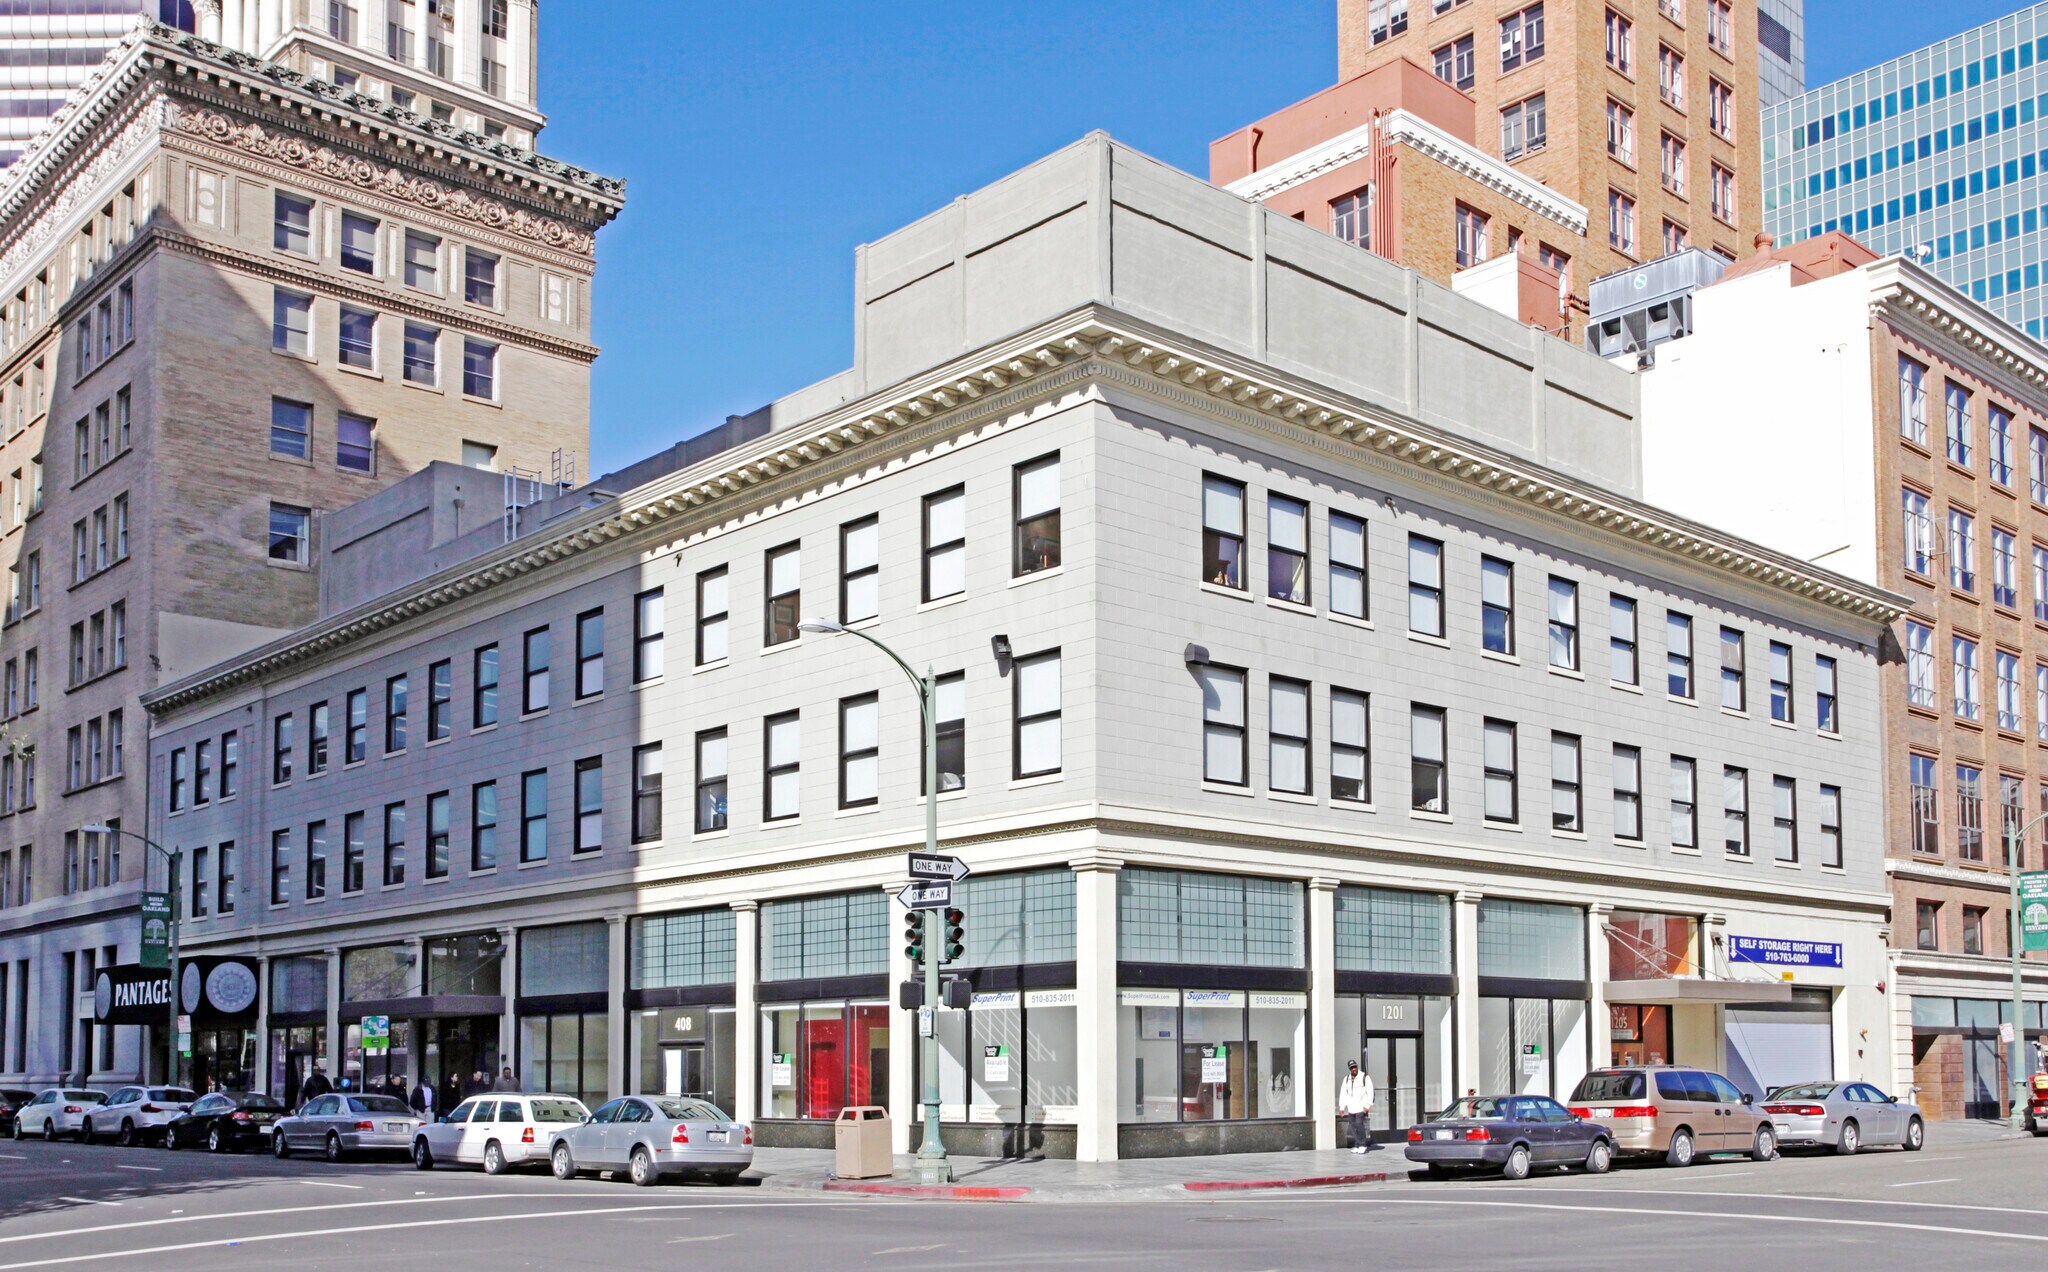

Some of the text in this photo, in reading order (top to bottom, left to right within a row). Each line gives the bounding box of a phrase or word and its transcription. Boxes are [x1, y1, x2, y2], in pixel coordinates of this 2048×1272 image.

[915, 860, 952, 872] ONE WAY
[912, 889, 945, 901] ONE WAY
[1739, 938, 1833, 954] SELF STORAGE RIGHT HERE
[1765, 951, 1810, 963] 510-763-6000
[972, 992, 1016, 1005] SuperPrint
[1031, 993, 1075, 1004] 510-835-2011
[1186, 991, 1232, 1002] SuperPrint
[1255, 996, 1295, 1005] 510-835-2011
[1382, 1005, 1403, 1020] 1201
[378, 1019, 386, 1028] P
[674, 1016, 692, 1031] 408
[1611, 1016, 1628, 1029] 1205
